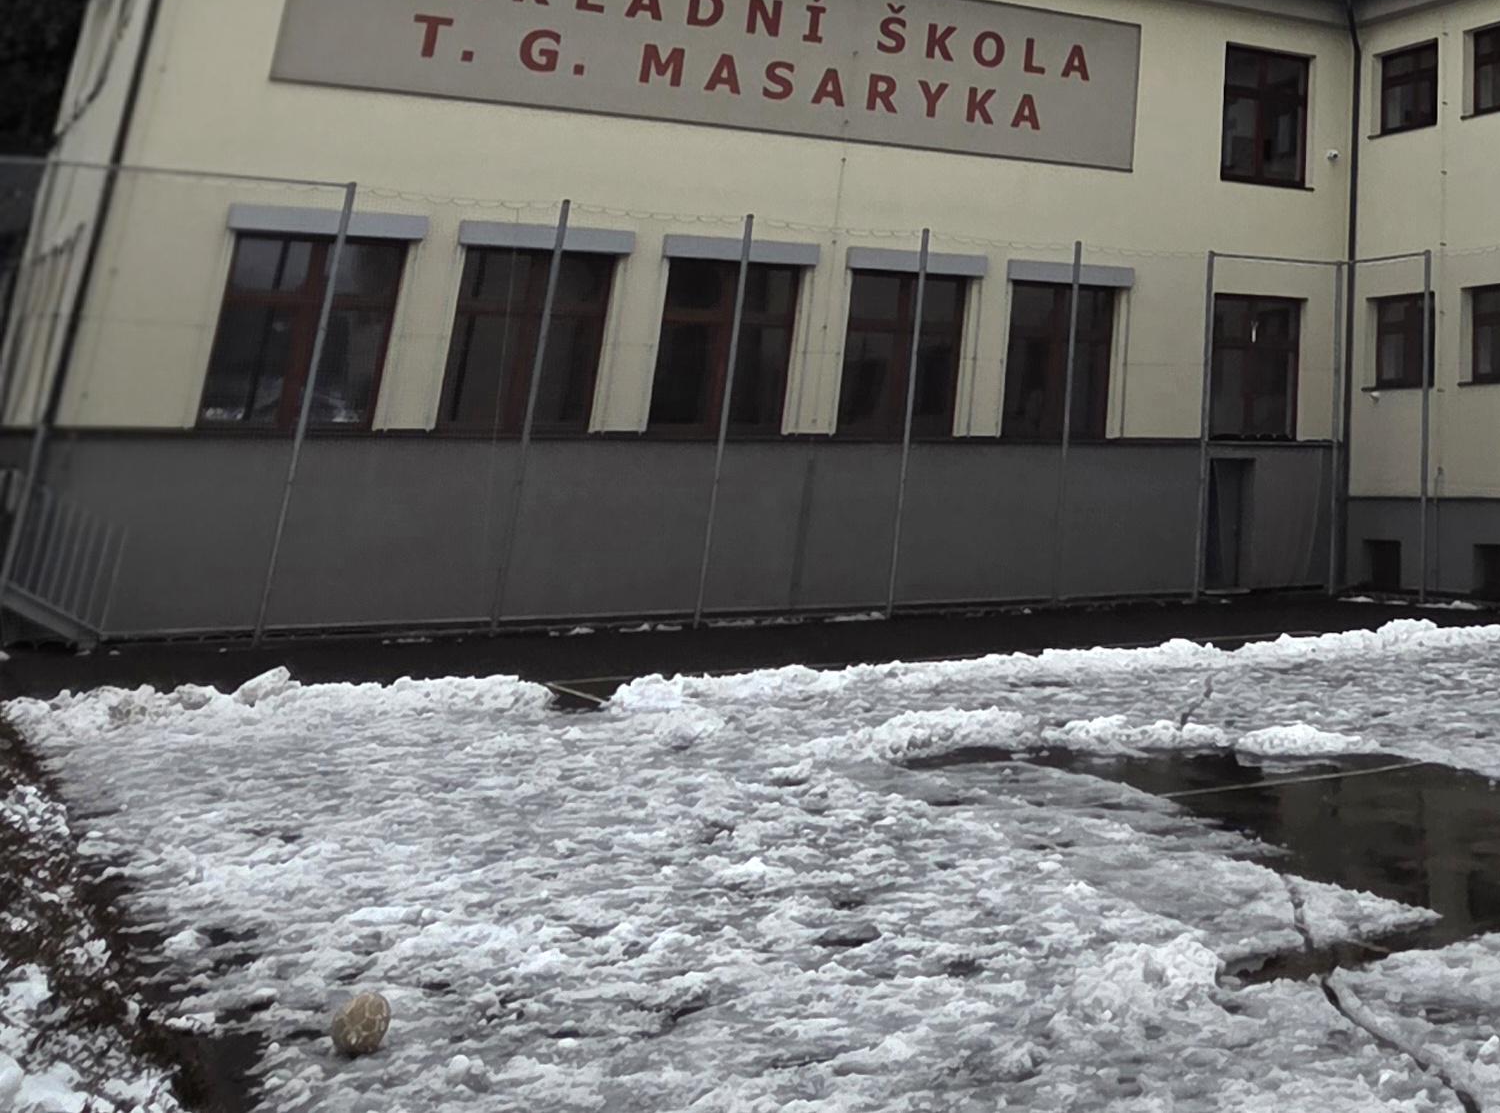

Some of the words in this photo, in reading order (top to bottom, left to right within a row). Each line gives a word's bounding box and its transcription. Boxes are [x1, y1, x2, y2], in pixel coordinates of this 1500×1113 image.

[413, 14, 475, 62] T.
[518, 27, 586, 77] G.
[638, 43, 1042, 132] MASARYKA
[877, 3, 1091, 83] ŠKOLA
